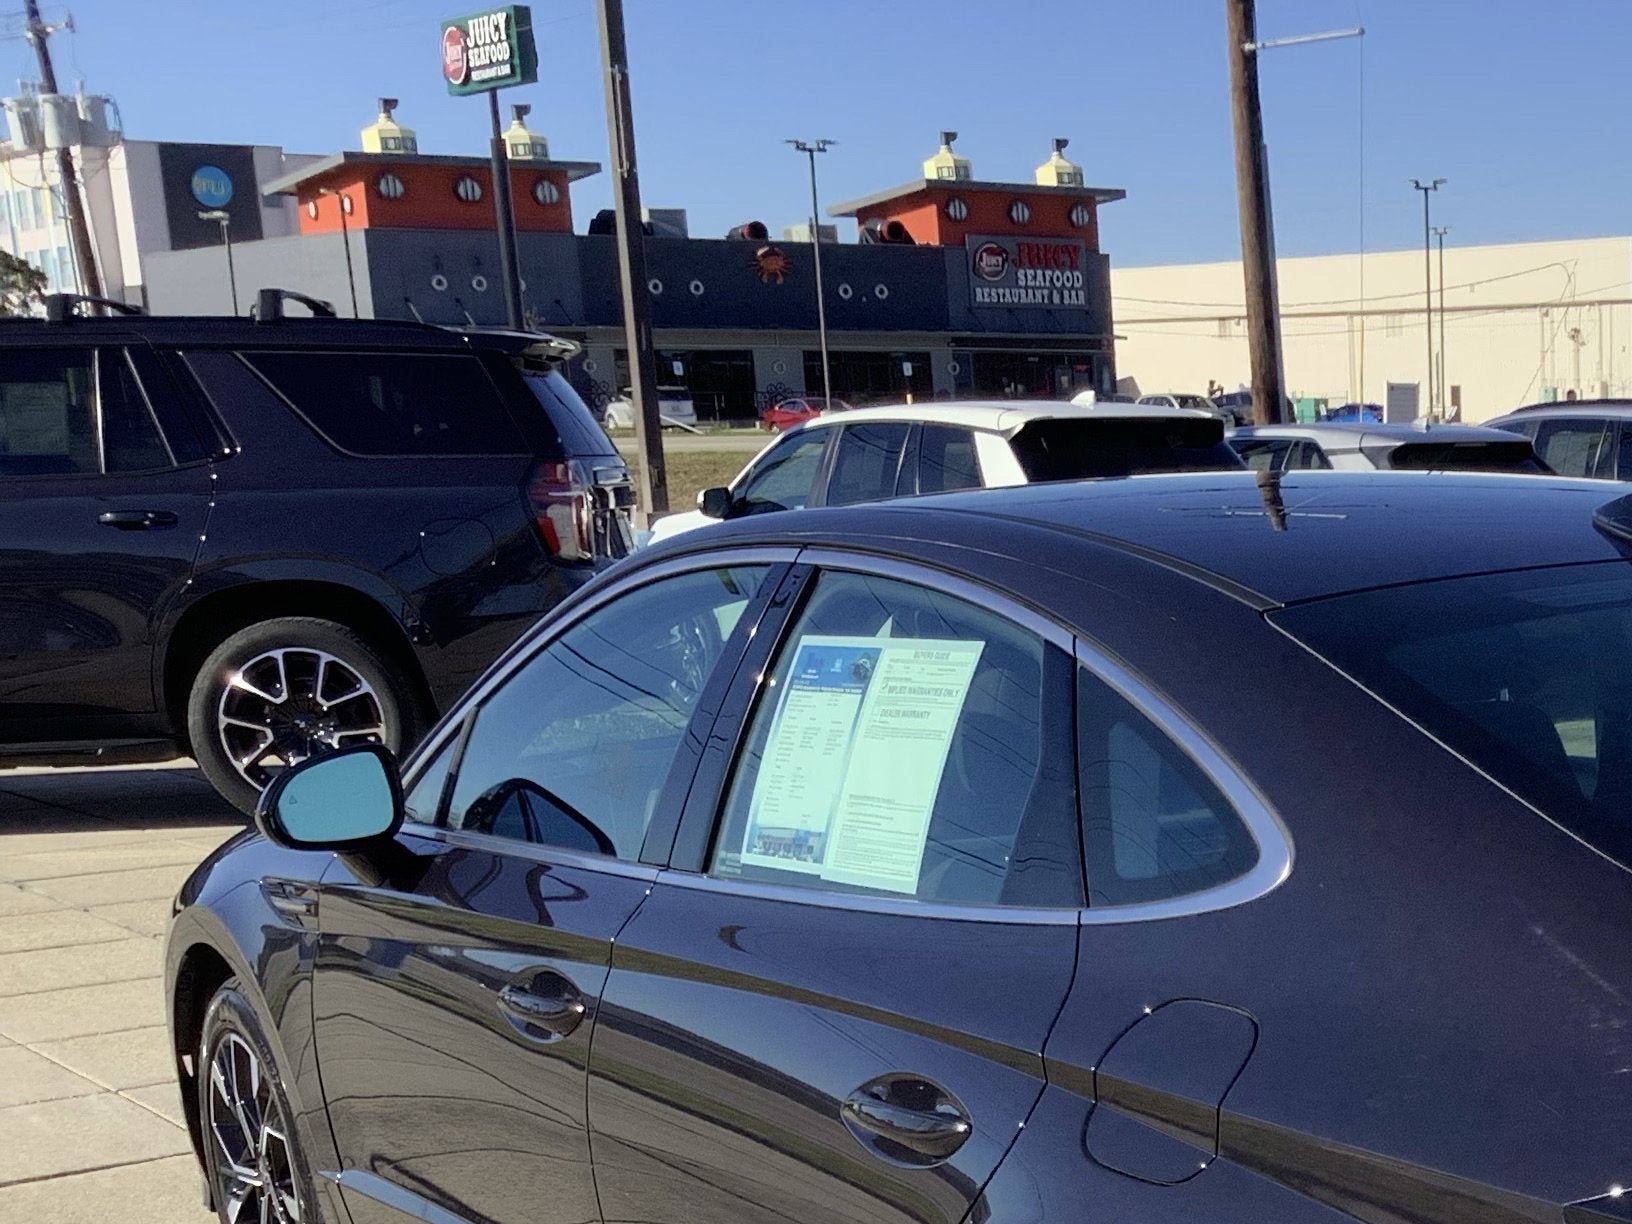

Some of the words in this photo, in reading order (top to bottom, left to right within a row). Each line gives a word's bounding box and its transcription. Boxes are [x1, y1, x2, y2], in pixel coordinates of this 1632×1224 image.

[466, 12, 507, 48] JUICY
[468, 41, 510, 68] SEAFOOD
[1012, 242, 1081, 269] JUICY
[1017, 269, 1083, 287] SEAFOOD
[975, 287, 1049, 304] RESTAURANT
[1052, 290, 1061, 304] &
[1062, 290, 1085, 305] BAR
